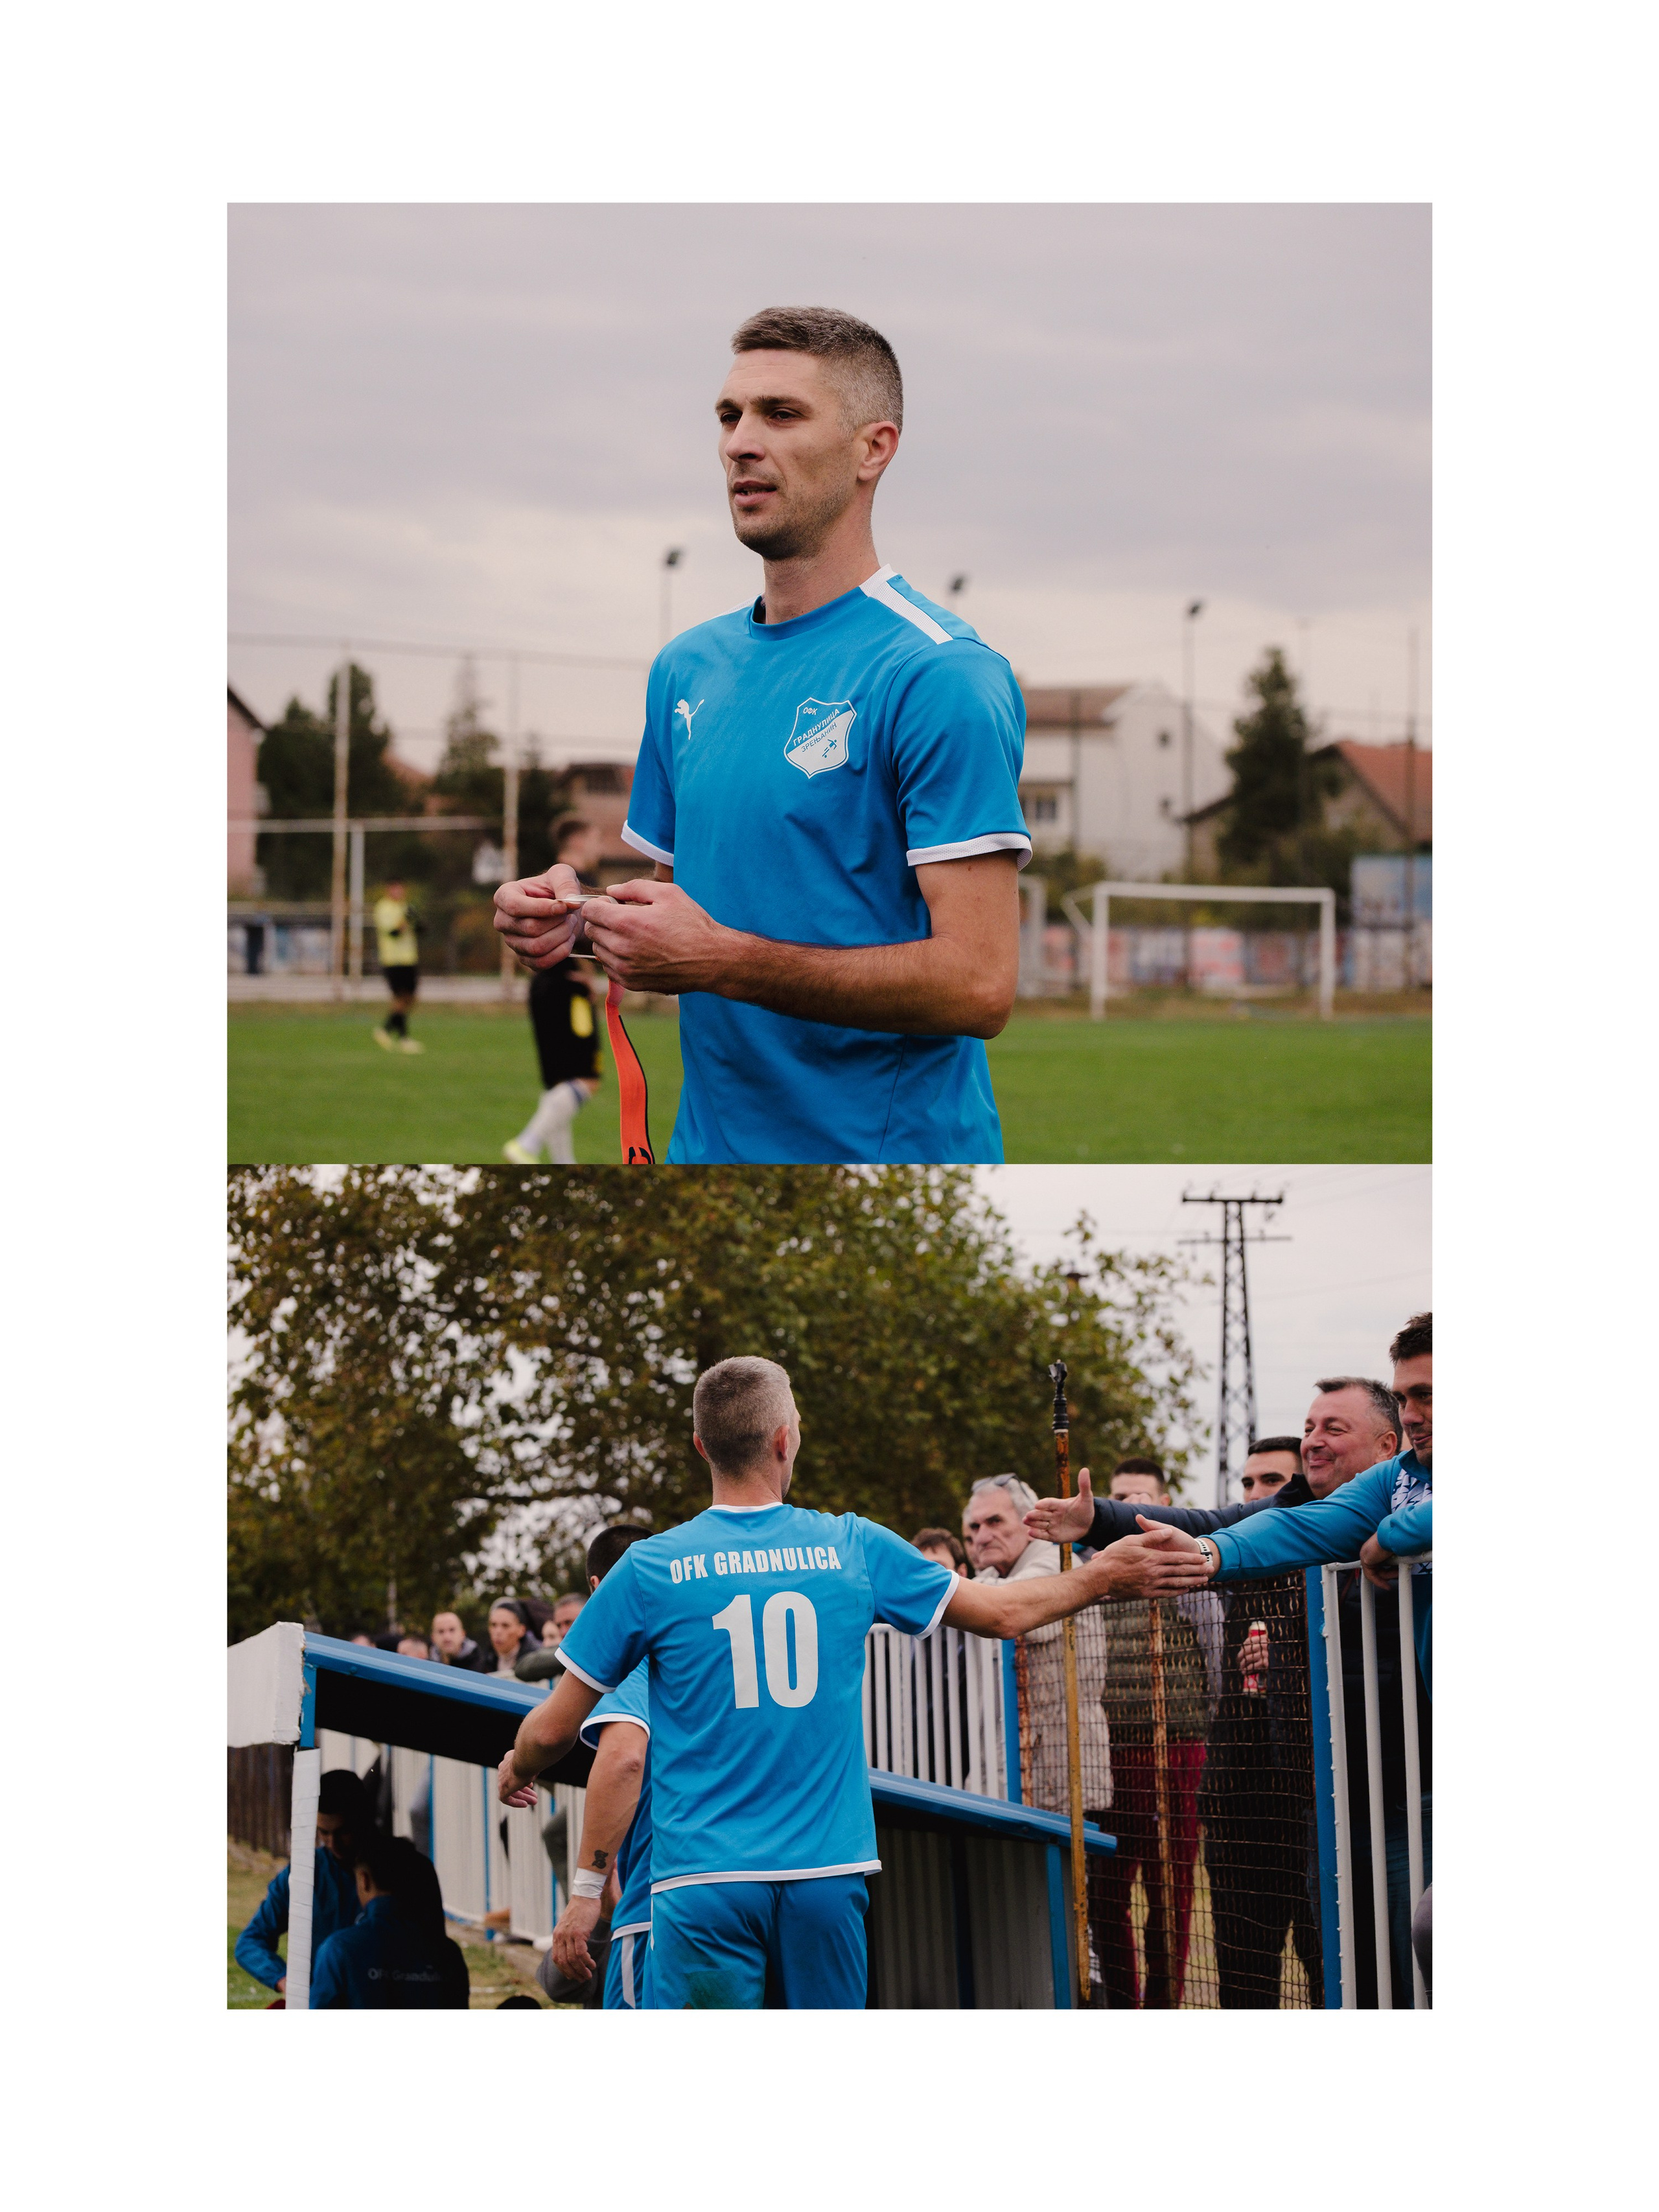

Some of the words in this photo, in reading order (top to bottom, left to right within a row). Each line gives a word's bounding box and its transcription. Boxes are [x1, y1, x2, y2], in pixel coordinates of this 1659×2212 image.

[793, 708, 840, 747] ГРАДНУЛИЦА
[803, 706, 818, 716] ОФК
[801, 722, 837, 752] ЗРЕЊАНИН
[669, 1554, 708, 1584] OFK
[713, 1546, 842, 1576] GRADNULICA
[712, 1591, 818, 1709] 10
